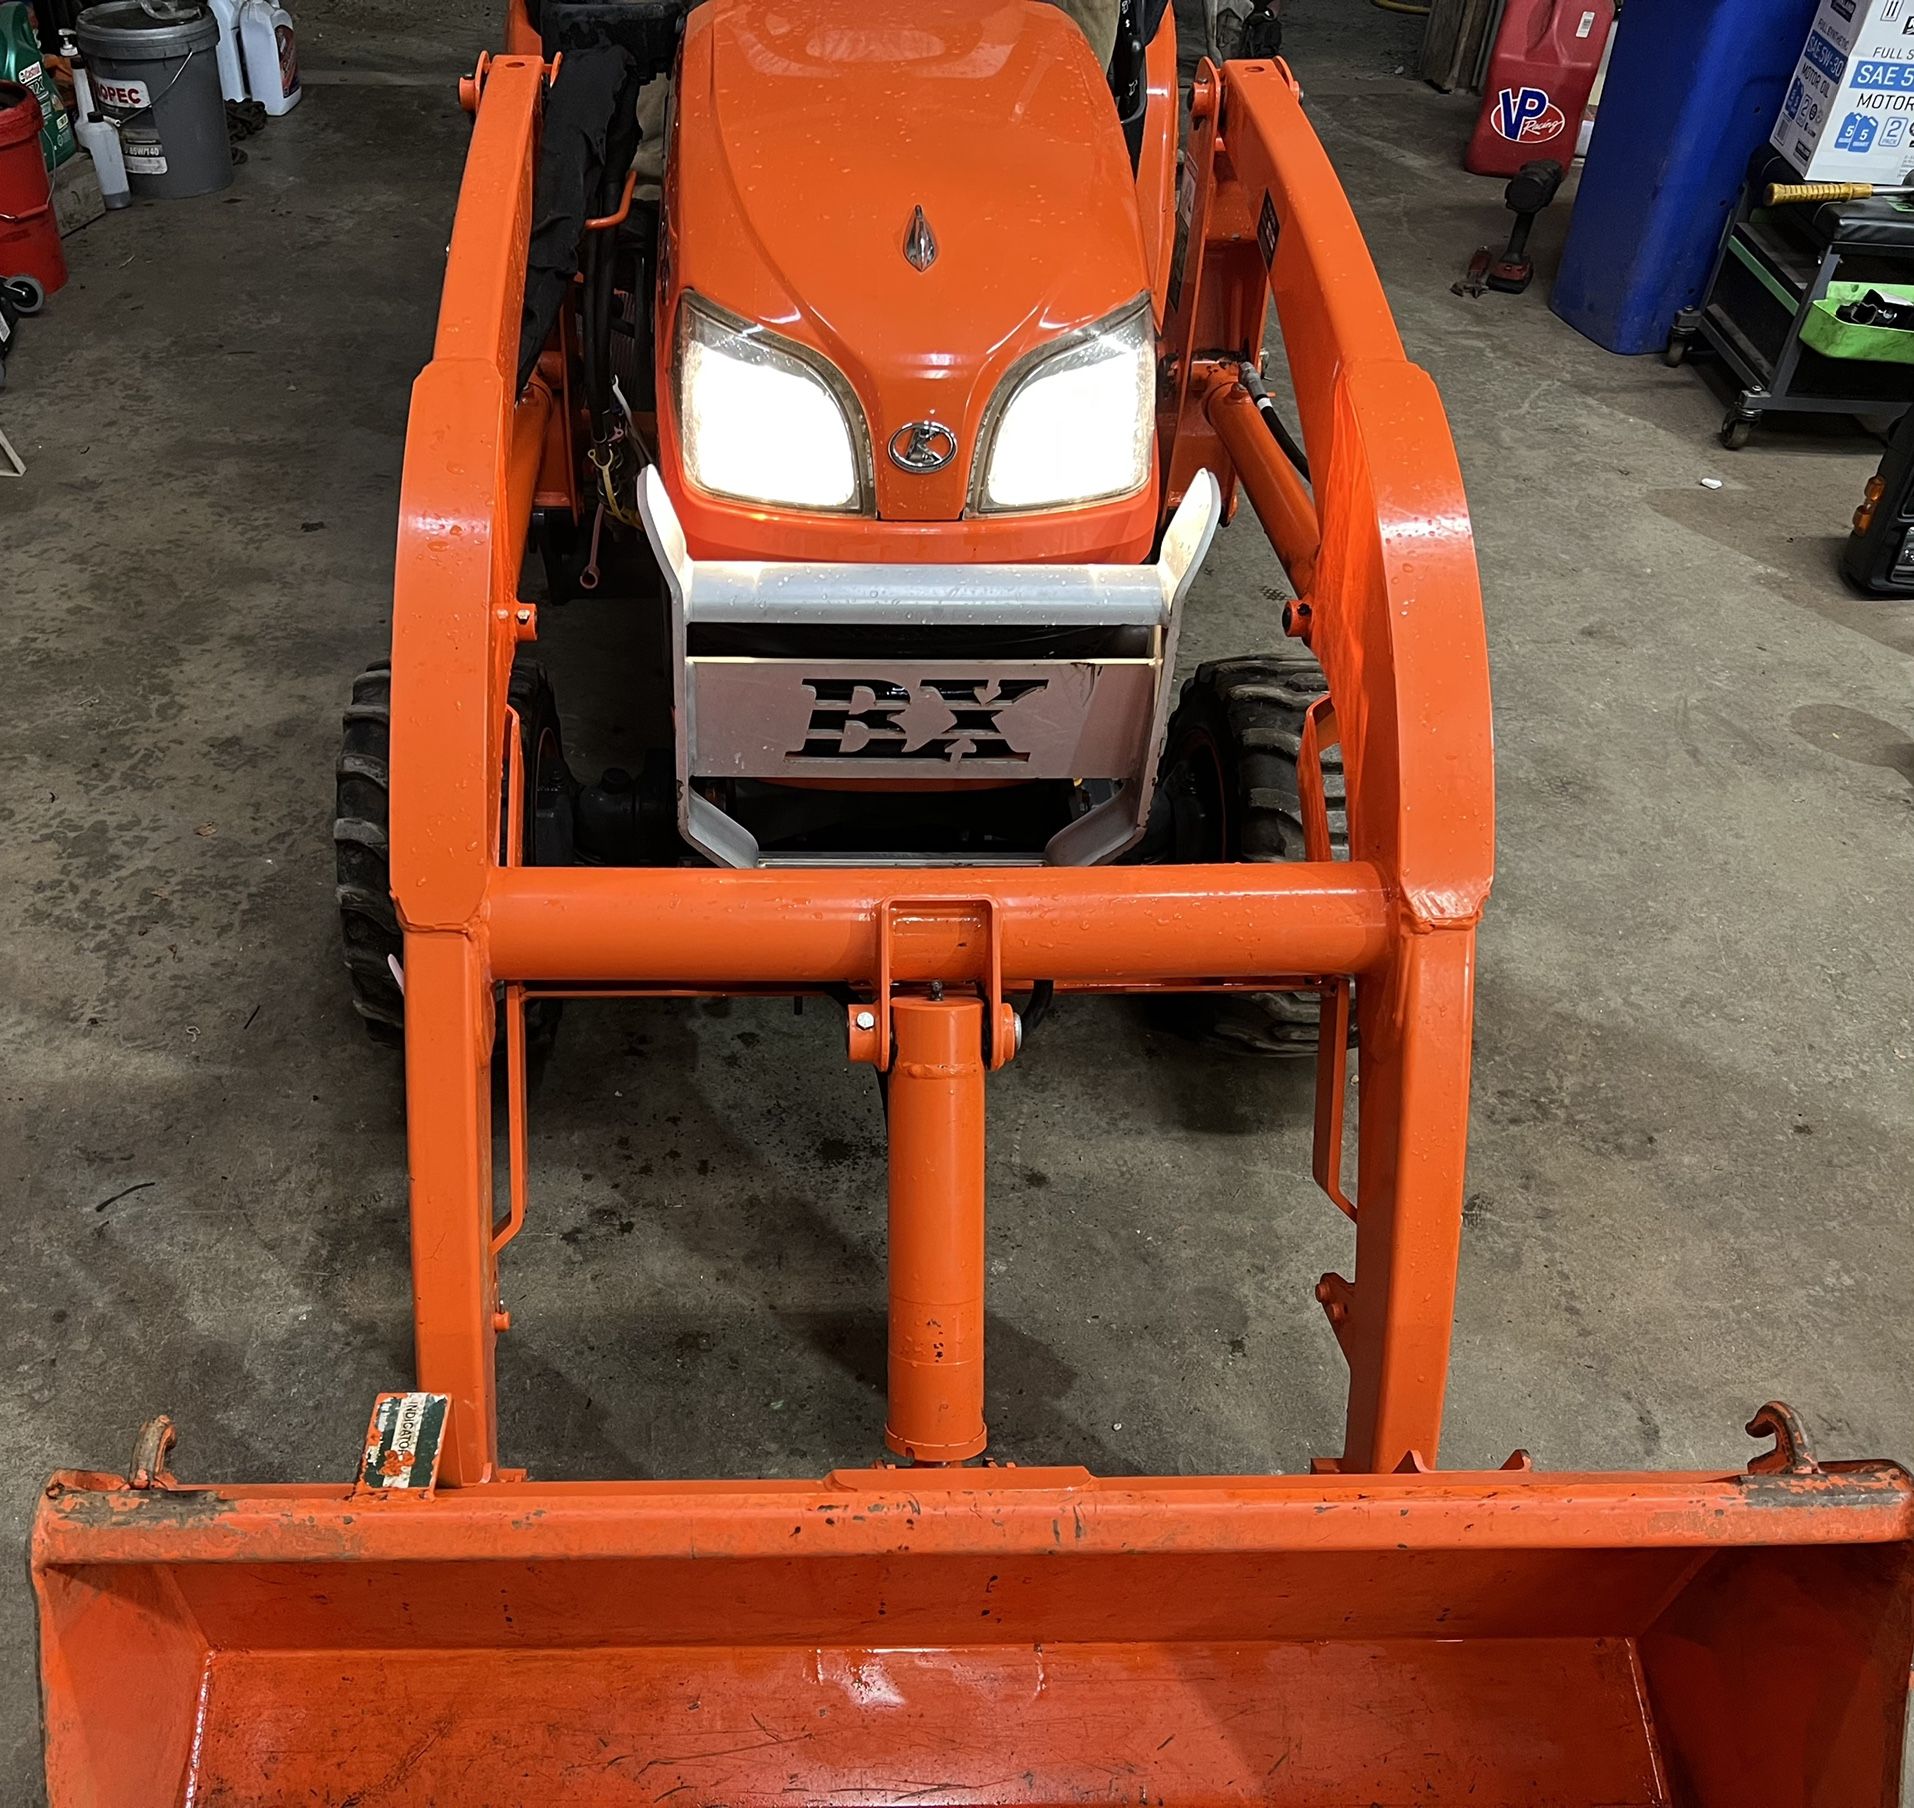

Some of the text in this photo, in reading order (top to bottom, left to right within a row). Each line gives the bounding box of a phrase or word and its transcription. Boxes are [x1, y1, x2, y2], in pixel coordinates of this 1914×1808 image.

[1807, 36, 1822, 58] SAE
[1872, 46, 1902, 60] FULL
[1802, 62, 1821, 89] MOTOR
[1857, 64, 1900, 85] SAE
[1499, 87, 1549, 141] VP
[1521, 119, 1564, 136] Racing
[1845, 125, 1855, 137] 5
[1860, 129, 1870, 141] 5
[1886, 120, 1902, 138] 2
[784, 678, 1049, 763] BX
